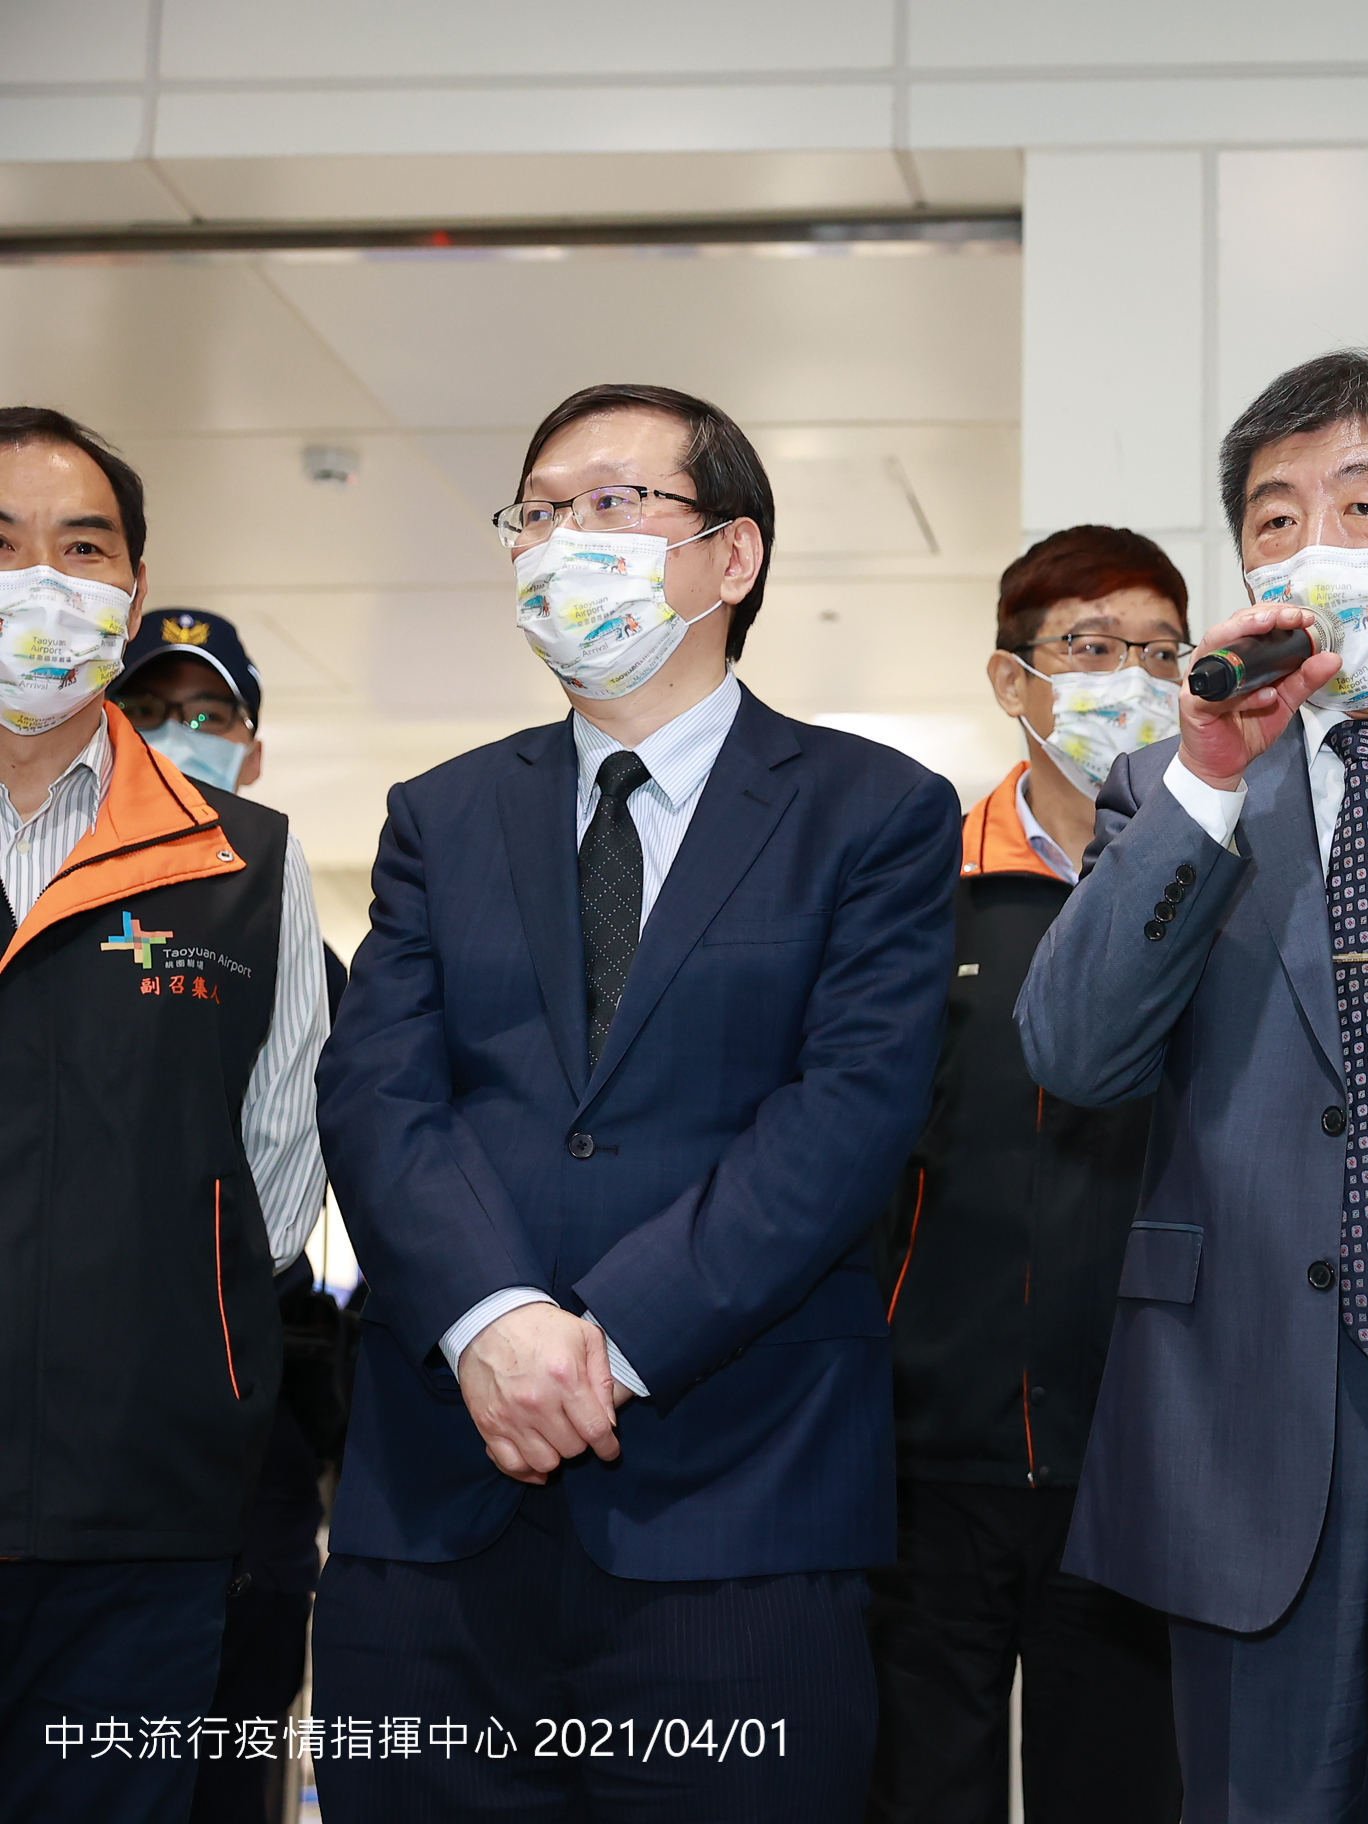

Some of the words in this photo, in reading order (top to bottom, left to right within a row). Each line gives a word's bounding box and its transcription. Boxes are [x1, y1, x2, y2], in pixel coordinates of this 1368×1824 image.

[1315, 584, 1352, 592] Taoyuan
[1317, 592, 1346, 601] Airport
[573, 597, 609, 611] Taoyuan
[575, 605, 605, 619] Airport
[33, 637, 67, 647] Taoyuan
[31, 645, 63, 655] Airport
[582, 644, 609, 658] Arrival
[1335, 665, 1368, 685] Taoyuan
[19, 680, 49, 690] Arrival
[1338, 676, 1368, 691] Airport
[163, 947, 217, 961] Taoyuan
[217, 954, 252, 979] Airport
[140, 974, 222, 1005] 副召集人
